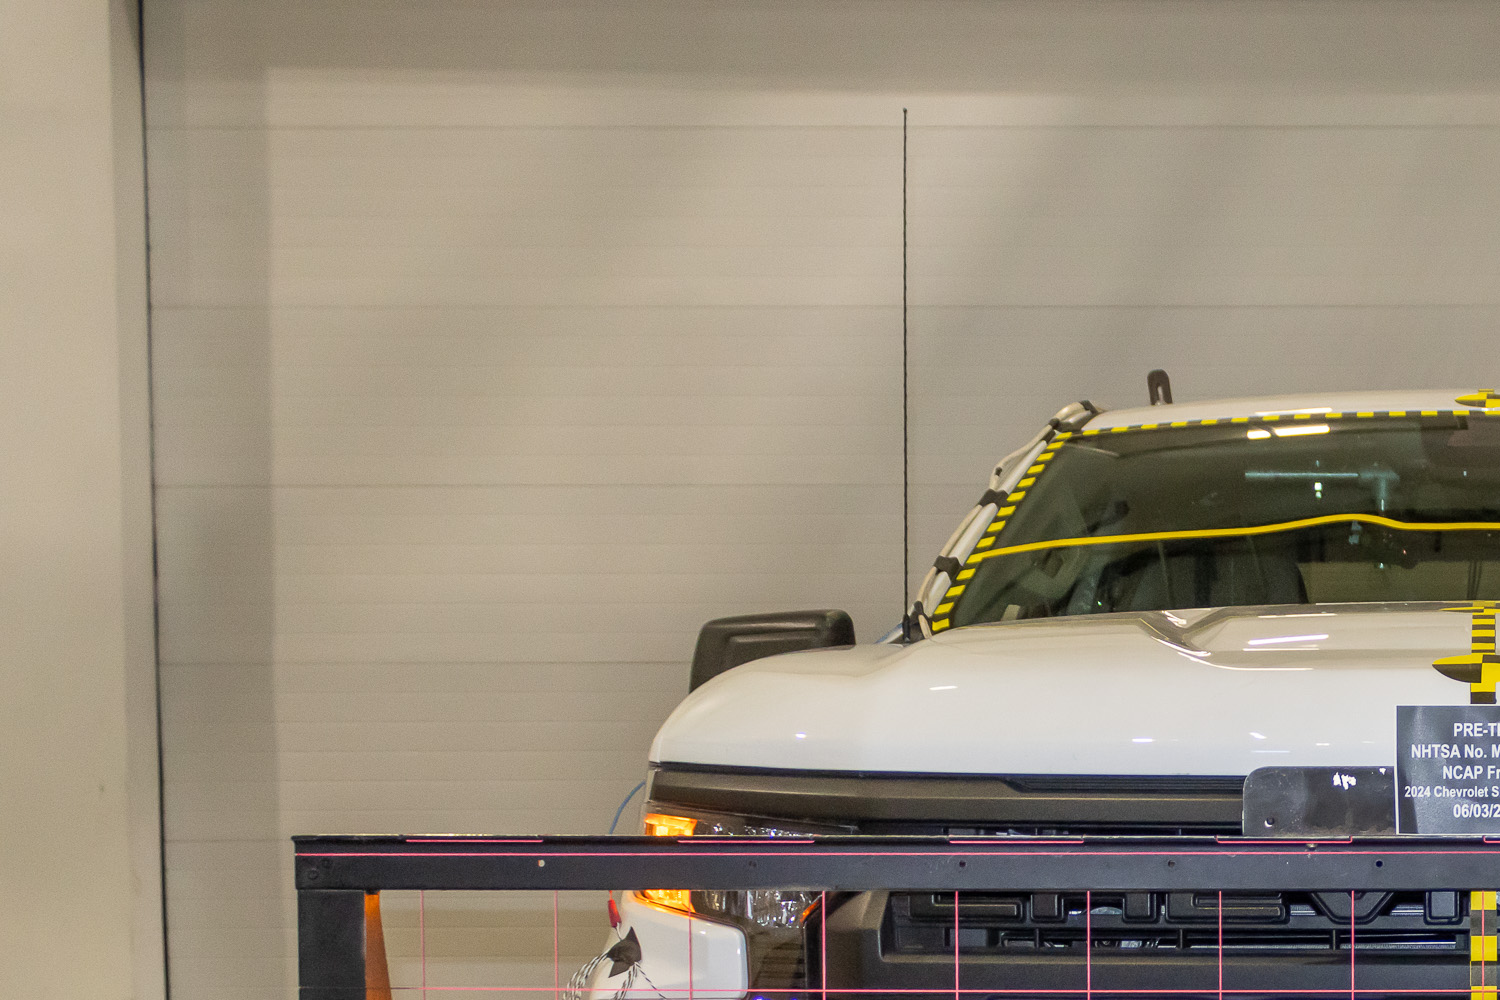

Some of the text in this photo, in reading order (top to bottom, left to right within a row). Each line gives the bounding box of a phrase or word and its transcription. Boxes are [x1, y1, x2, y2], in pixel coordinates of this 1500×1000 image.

[1411, 744, 1461, 758] NHTSA
[1464, 744, 1487, 758] No.
[1442, 765, 1483, 780] NCAP
[1404, 786, 1431, 798] 2024
[1433, 785, 1489, 798] Chevrolet
